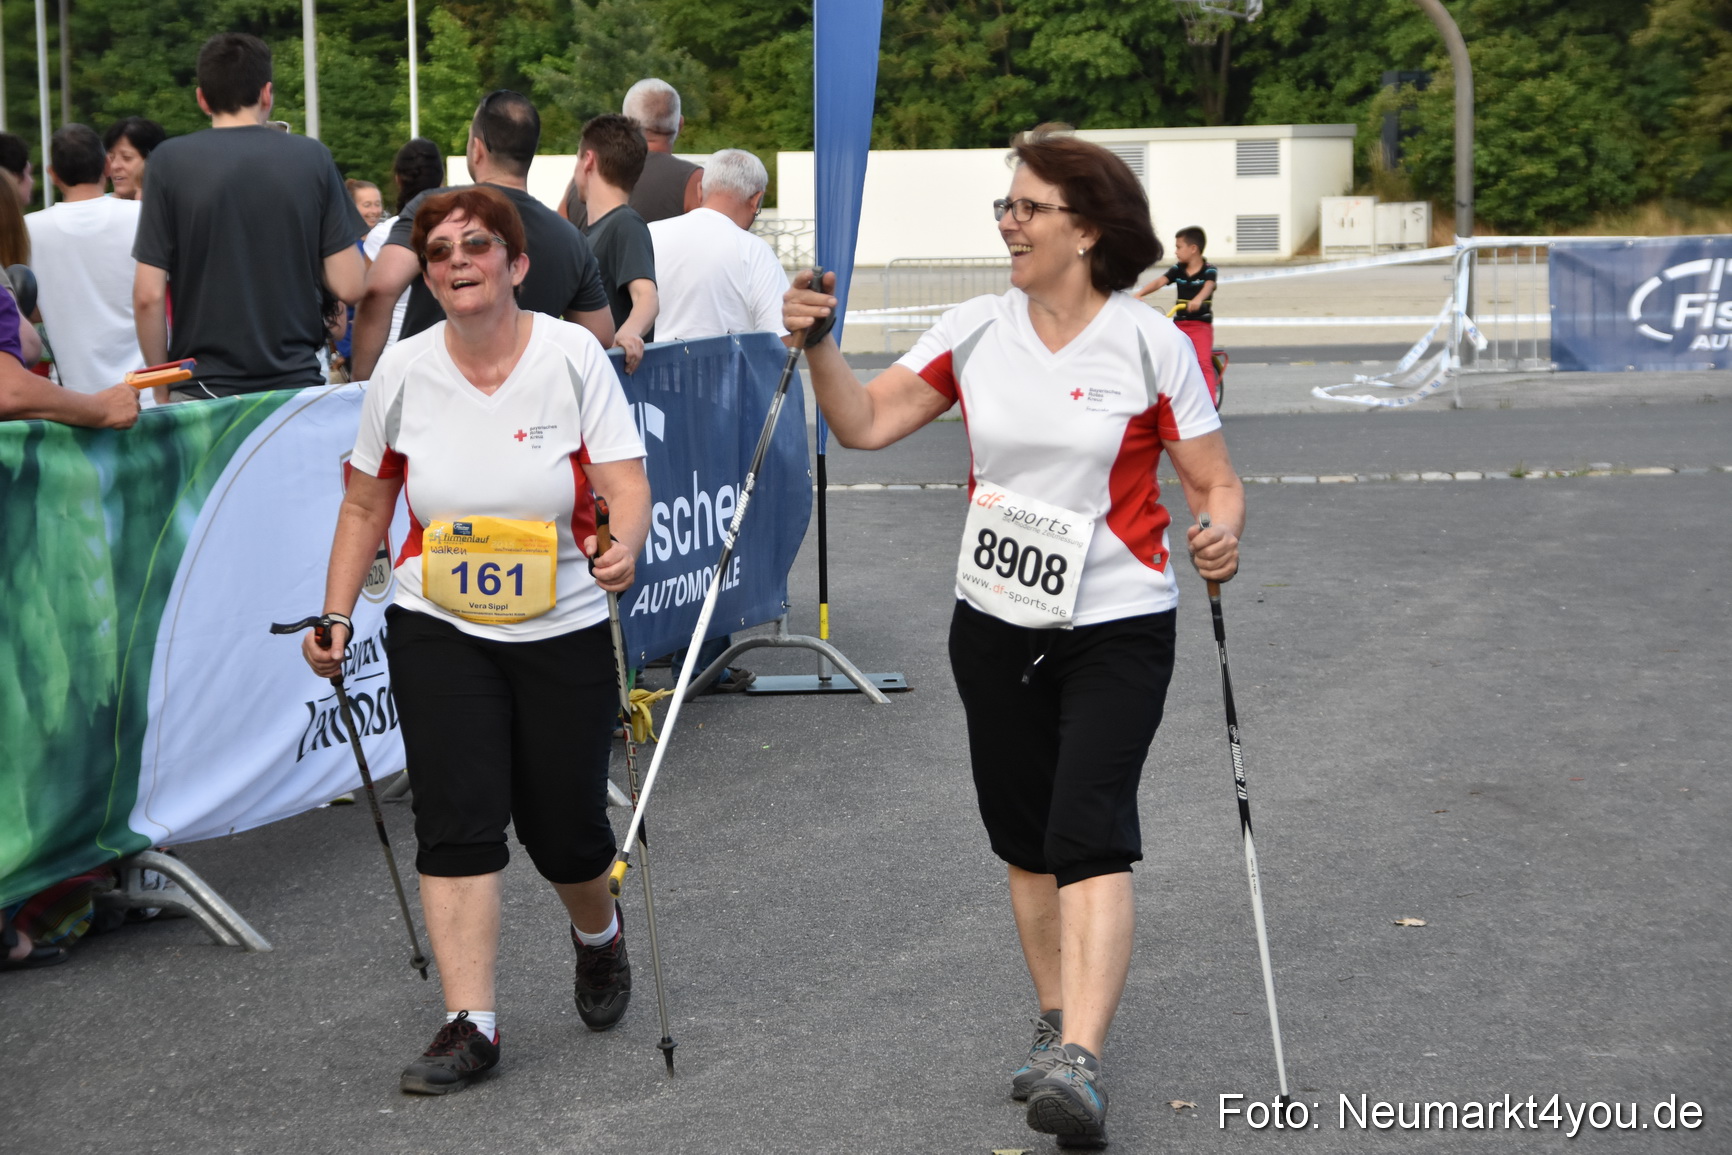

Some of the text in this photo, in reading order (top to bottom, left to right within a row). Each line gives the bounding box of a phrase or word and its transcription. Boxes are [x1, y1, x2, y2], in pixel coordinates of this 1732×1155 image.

[1690, 334, 1732, 350] AU
[976, 492, 1072, 535] df-sports
[430, 545, 467, 556] walken
[443, 533, 490, 544] firmenlauf
[451, 561, 523, 596] 161
[974, 528, 1067, 596] 8908
[630, 556, 740, 617] AUTOMOILE
[962, 571, 1067, 618] www.df-sports.de
[488, 603, 508, 611] Sippl
